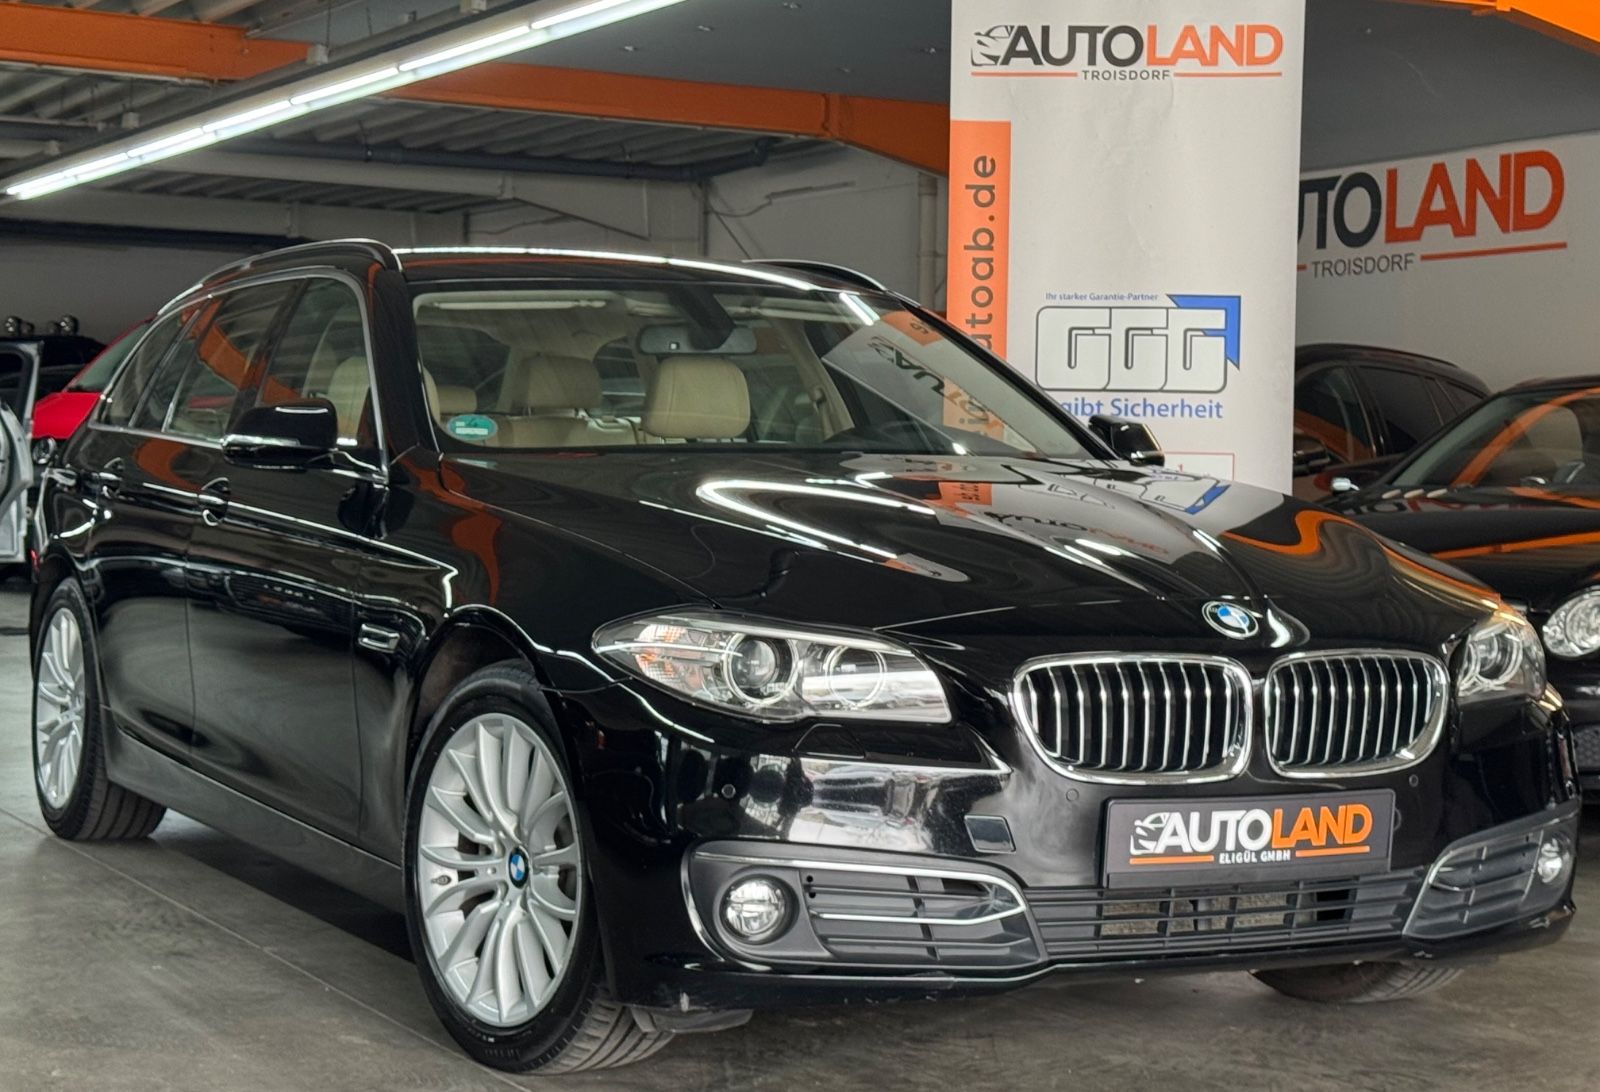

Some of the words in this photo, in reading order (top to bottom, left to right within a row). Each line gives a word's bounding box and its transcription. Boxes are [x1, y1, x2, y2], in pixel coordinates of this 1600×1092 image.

[997, 24, 1284, 67] AUTOLAND
[1081, 69, 1171, 81] TROISDORF
[963, 155, 997, 350] utoab.de
[1310, 252, 1416, 279] TROISDORF
[1045, 292, 1057, 301] Ihr
[1059, 292, 1087, 301] starker
[1110, 398, 1224, 419] Sicherheit
[1153, 803, 1374, 854] AUTOLAND
